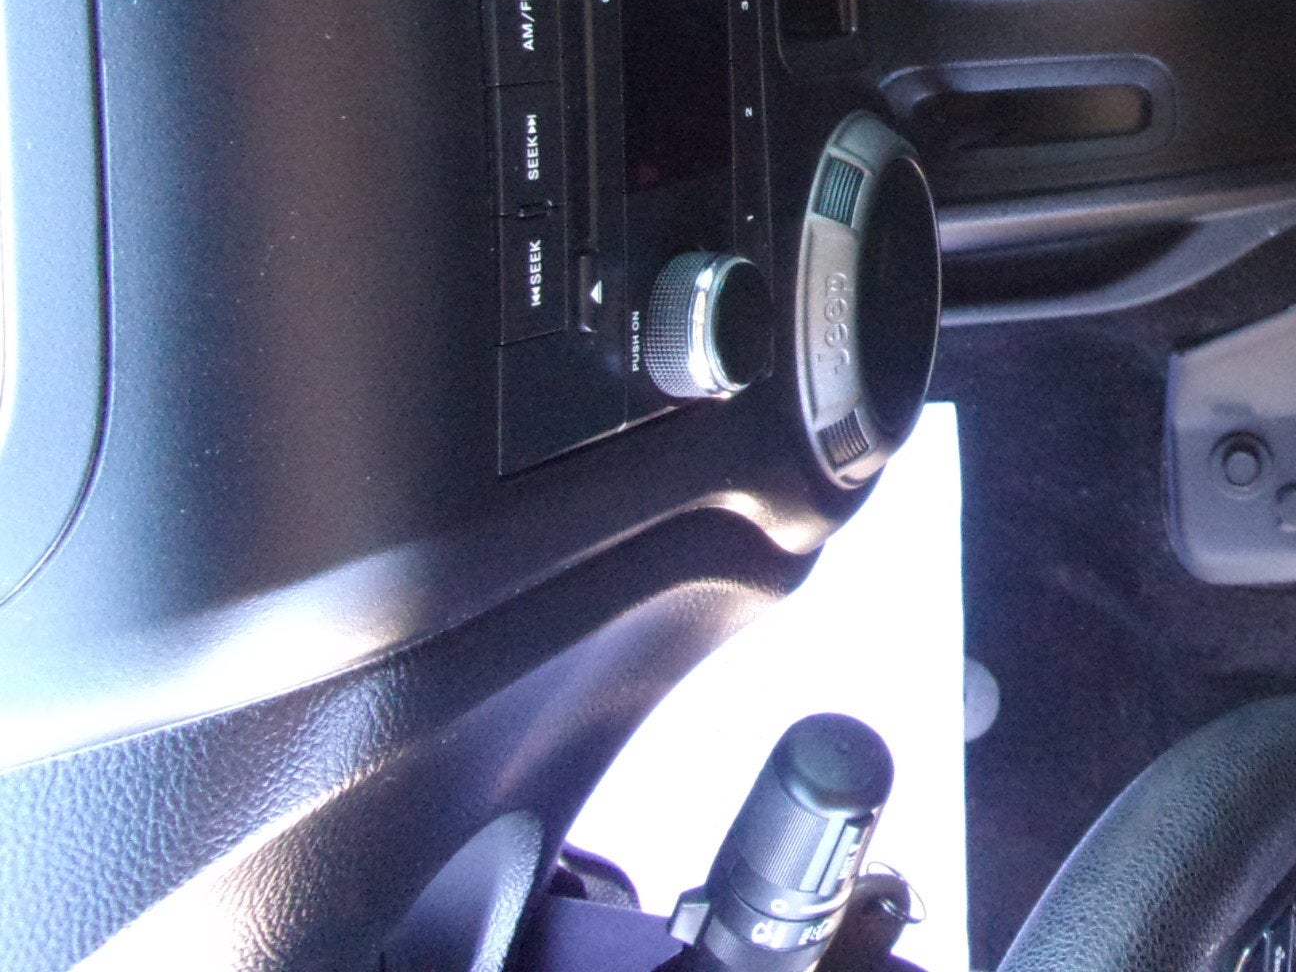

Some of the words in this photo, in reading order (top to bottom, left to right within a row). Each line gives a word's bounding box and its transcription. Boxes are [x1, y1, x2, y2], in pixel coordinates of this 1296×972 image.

[526, 135, 539, 181] SEEK
[529, 240, 542, 285] SEEK
[631, 311, 640, 332] ON
[817, 272, 851, 375] Jeep
[631, 335, 640, 372] PUSH
